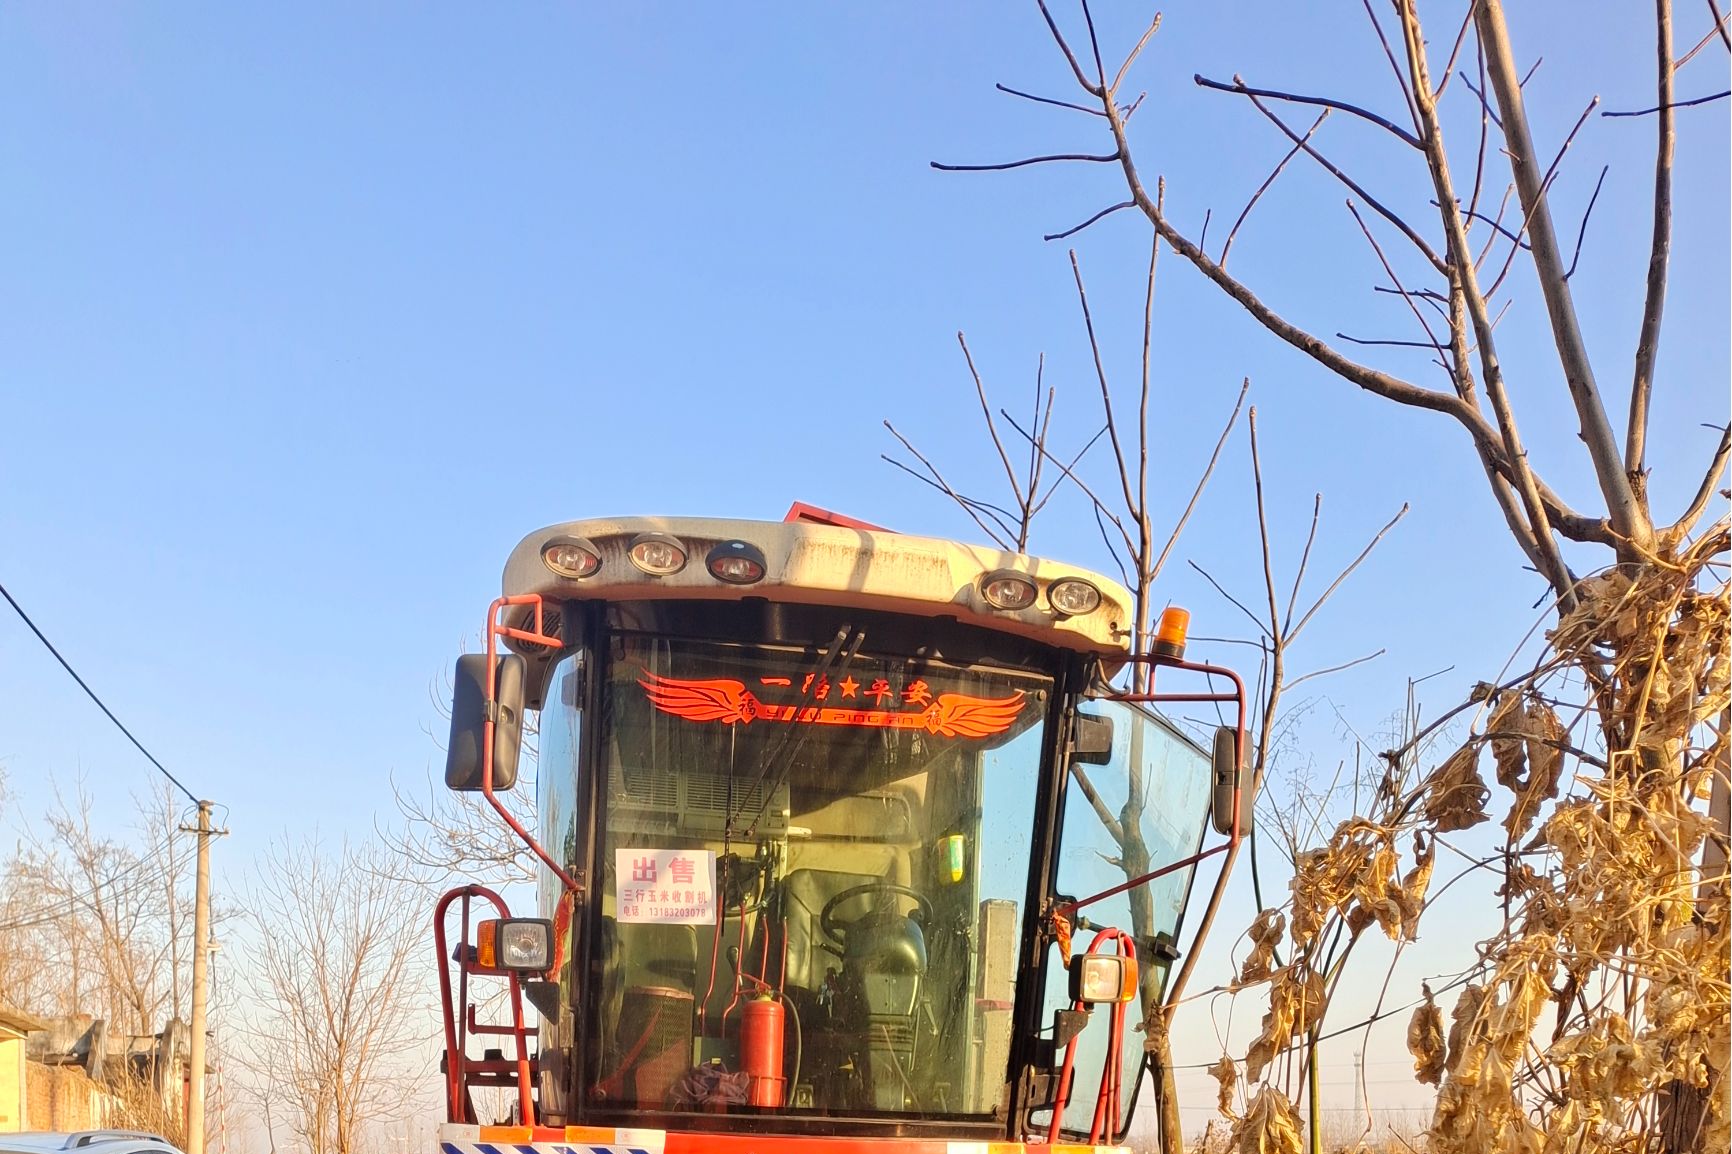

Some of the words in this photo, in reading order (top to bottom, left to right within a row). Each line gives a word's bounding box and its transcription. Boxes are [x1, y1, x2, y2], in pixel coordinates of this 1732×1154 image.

[739, 698, 756, 716] 福
[926, 709, 942, 726] 福
[632, 856, 695, 884] 出售
[624, 889, 707, 904] 三行玉米收割机
